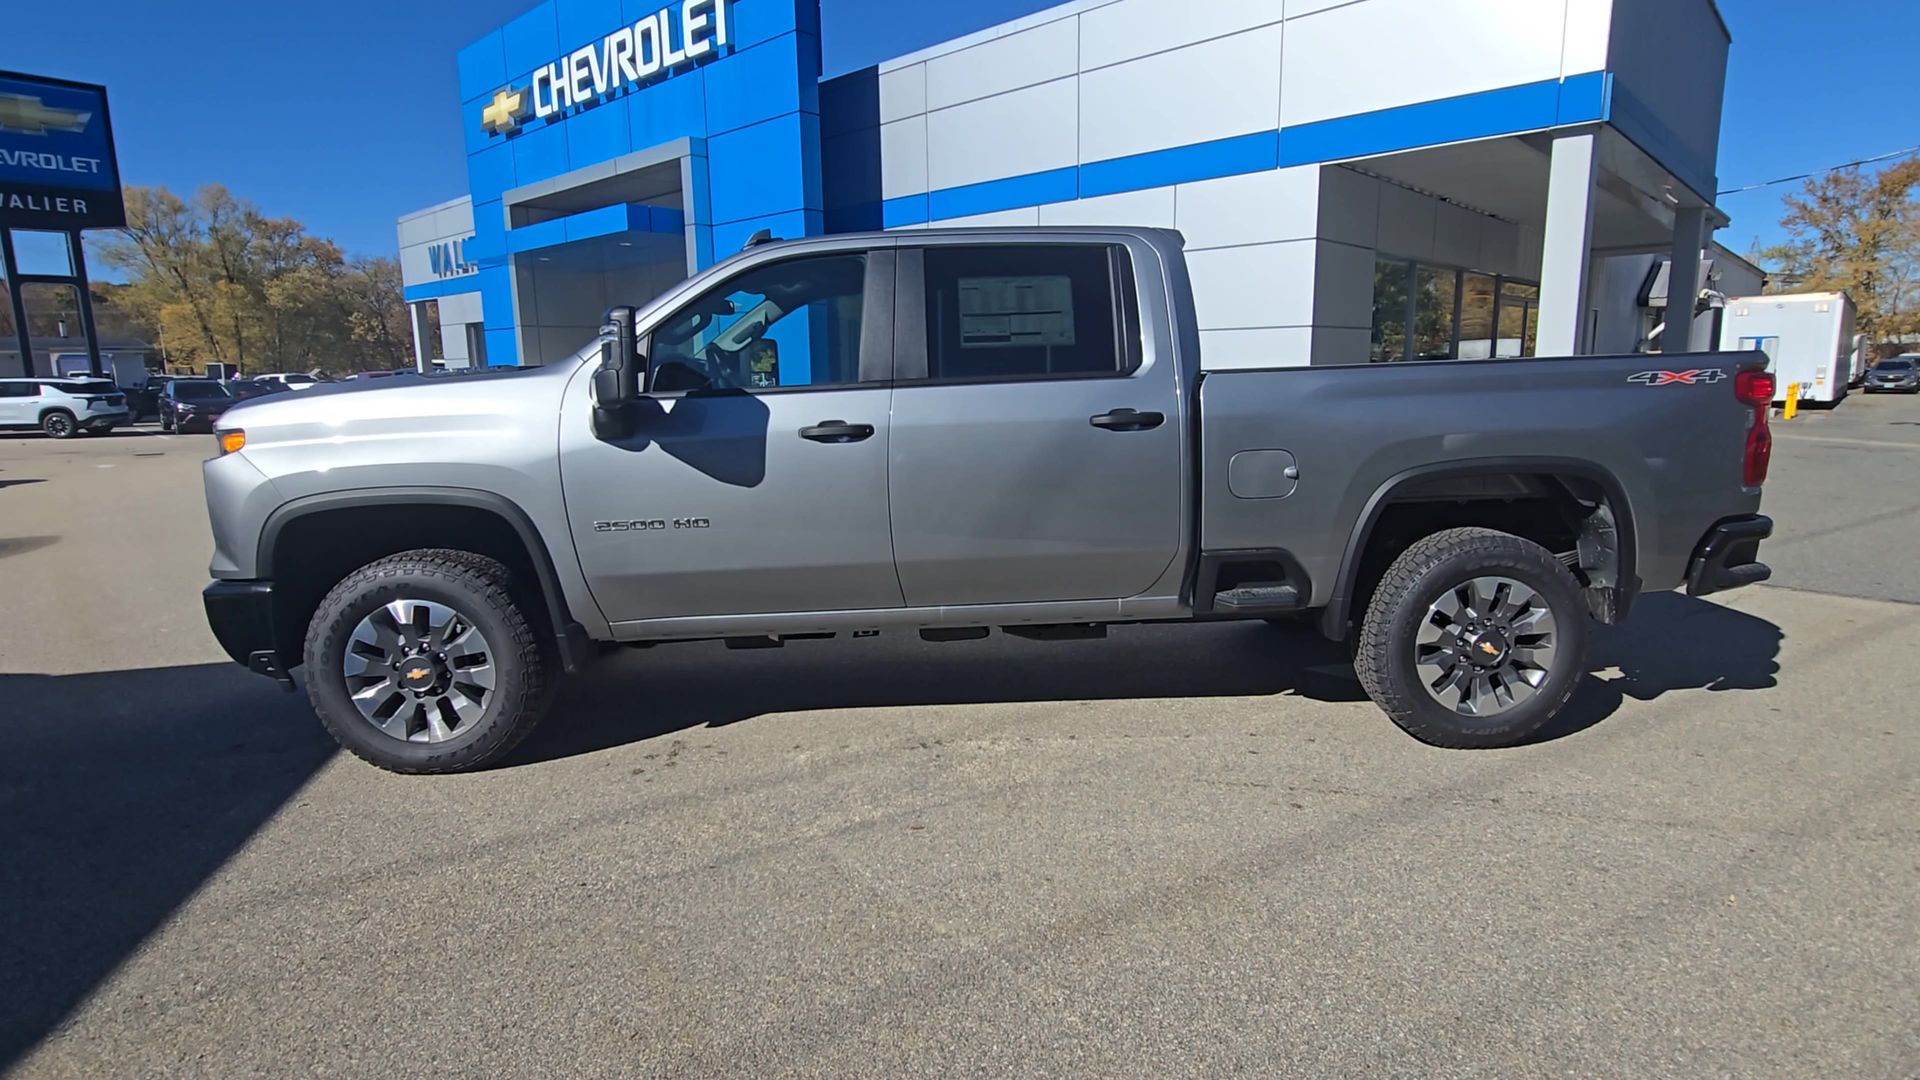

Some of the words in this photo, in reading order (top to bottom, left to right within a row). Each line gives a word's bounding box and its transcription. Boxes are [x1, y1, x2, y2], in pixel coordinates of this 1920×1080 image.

[0, 192, 88, 214] ALIER
[594, 519, 666, 532] 2500
[673, 517, 710, 530] HD
